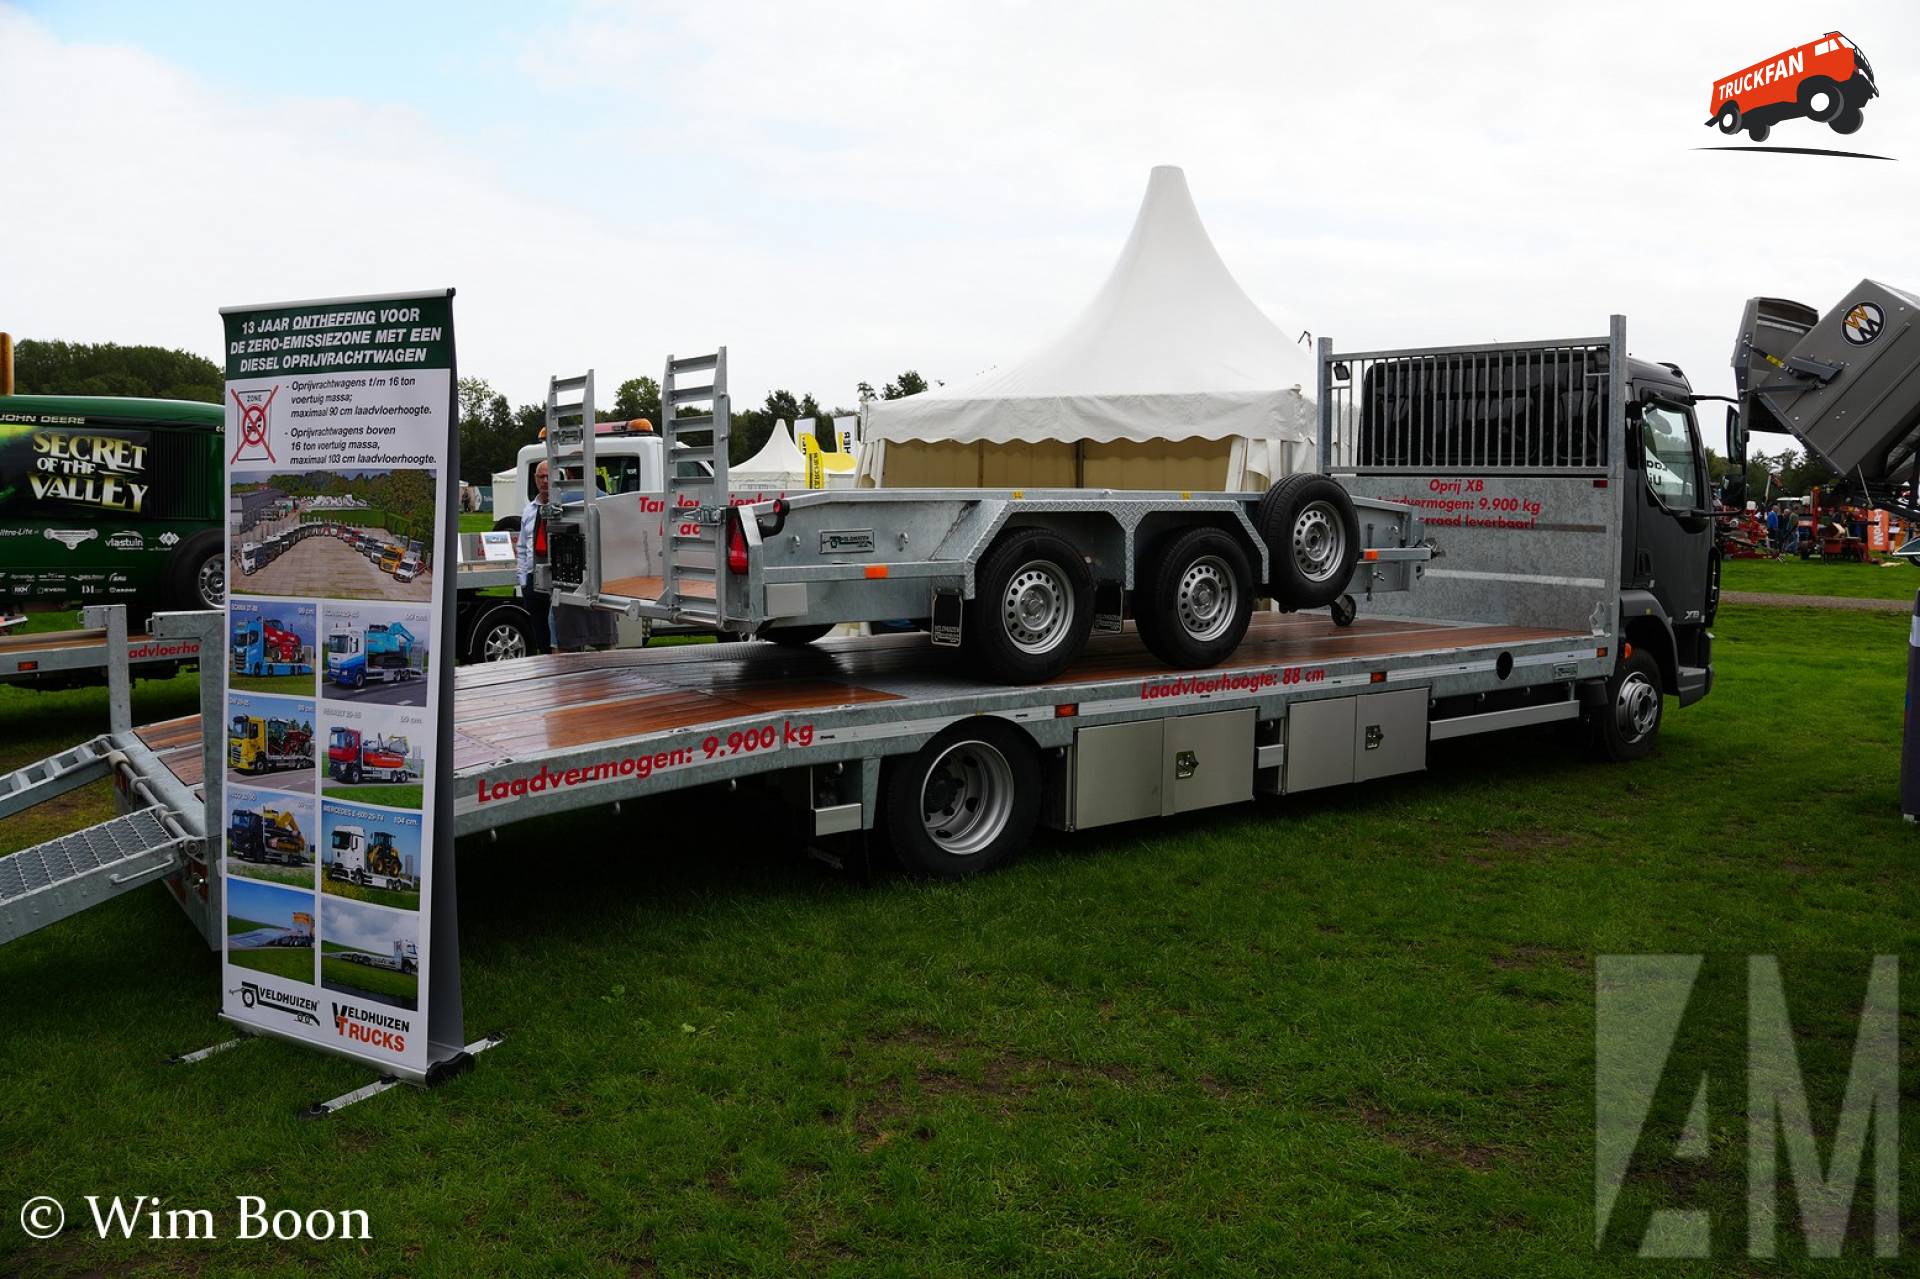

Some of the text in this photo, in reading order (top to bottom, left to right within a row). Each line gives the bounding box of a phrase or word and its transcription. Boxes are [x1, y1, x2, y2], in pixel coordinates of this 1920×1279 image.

[241, 308, 420, 335] 13 JAAR ONTHEFFING VOOR
[230, 326, 442, 355] DE ZERO-EMISSIEZONE MET EEN
[240, 347, 427, 373] DIESEL OPRIJVRACHTWAGEN
[292, 376, 416, 392] Oprijvrachtwagens t/m 16 ton
[291, 393, 324, 405] voertuig
[0, 414, 86, 425] JOHN DEERE
[290, 404, 432, 419] maximaal 90 cm laadvloerhoogte.
[291, 425, 396, 439] Oprijvrachtwagens boven
[33, 432, 148, 471] SECRET
[291, 441, 301, 452] 16
[303, 441, 316, 451] ton
[317, 440, 346, 452] voertuig
[36, 457, 96, 475] OF THE
[290, 452, 437, 466] maximaal 103 cm laadvloerhoogte.
[27, 471, 149, 514] VALLEY
[1429, 478, 1484, 495] Oprij XB
[1479, 497, 1519, 512] 9.900
[1522, 498, 1543, 515] kg
[105, 538, 144, 548] vlastuin
[1140, 667, 1325, 700] Laadvloerhoogte: 88 cm
[477, 720, 815, 803] Laadvermogen: 9.900 kg
[258, 986, 318, 1012] VELDHUIZEN
[331, 1001, 410, 1033] VELDHUIZEN
[335, 1015, 406, 1053] TRUCKS
